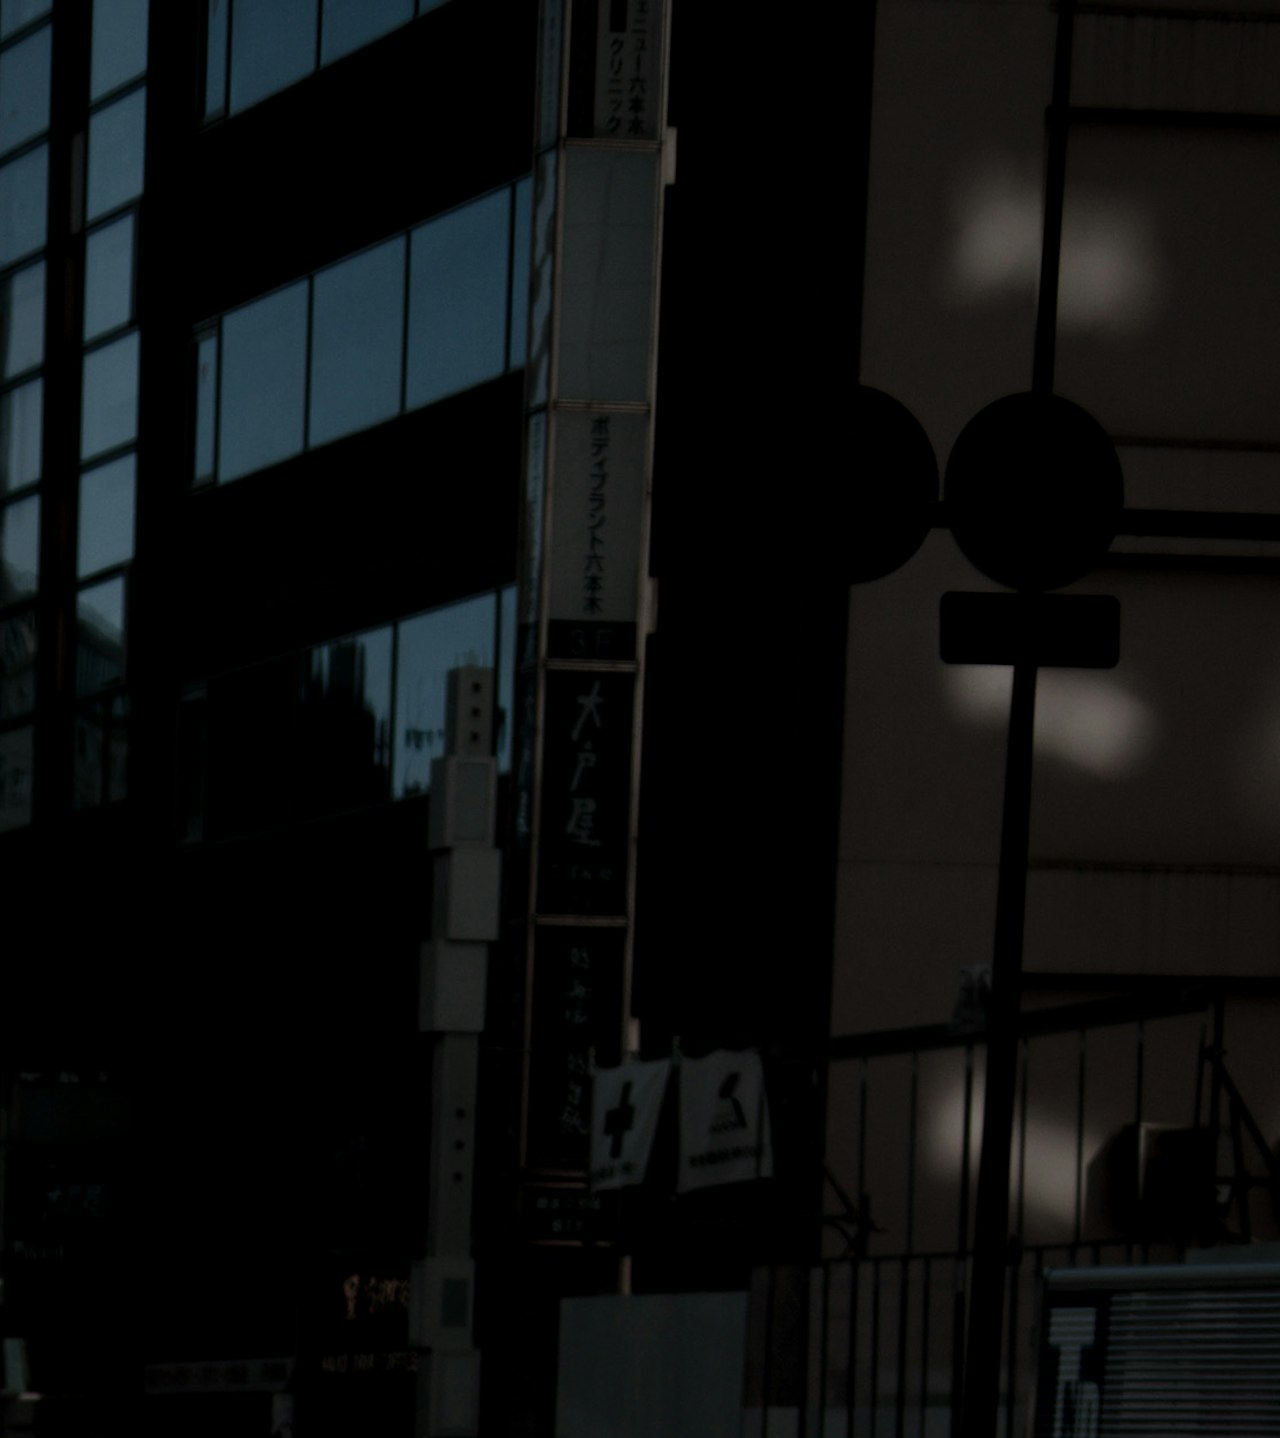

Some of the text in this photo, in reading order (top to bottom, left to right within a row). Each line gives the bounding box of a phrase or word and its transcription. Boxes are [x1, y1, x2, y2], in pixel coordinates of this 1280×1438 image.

[605, 37, 625, 134] クリニック
[565, 679, 604, 847] 大戸屋
